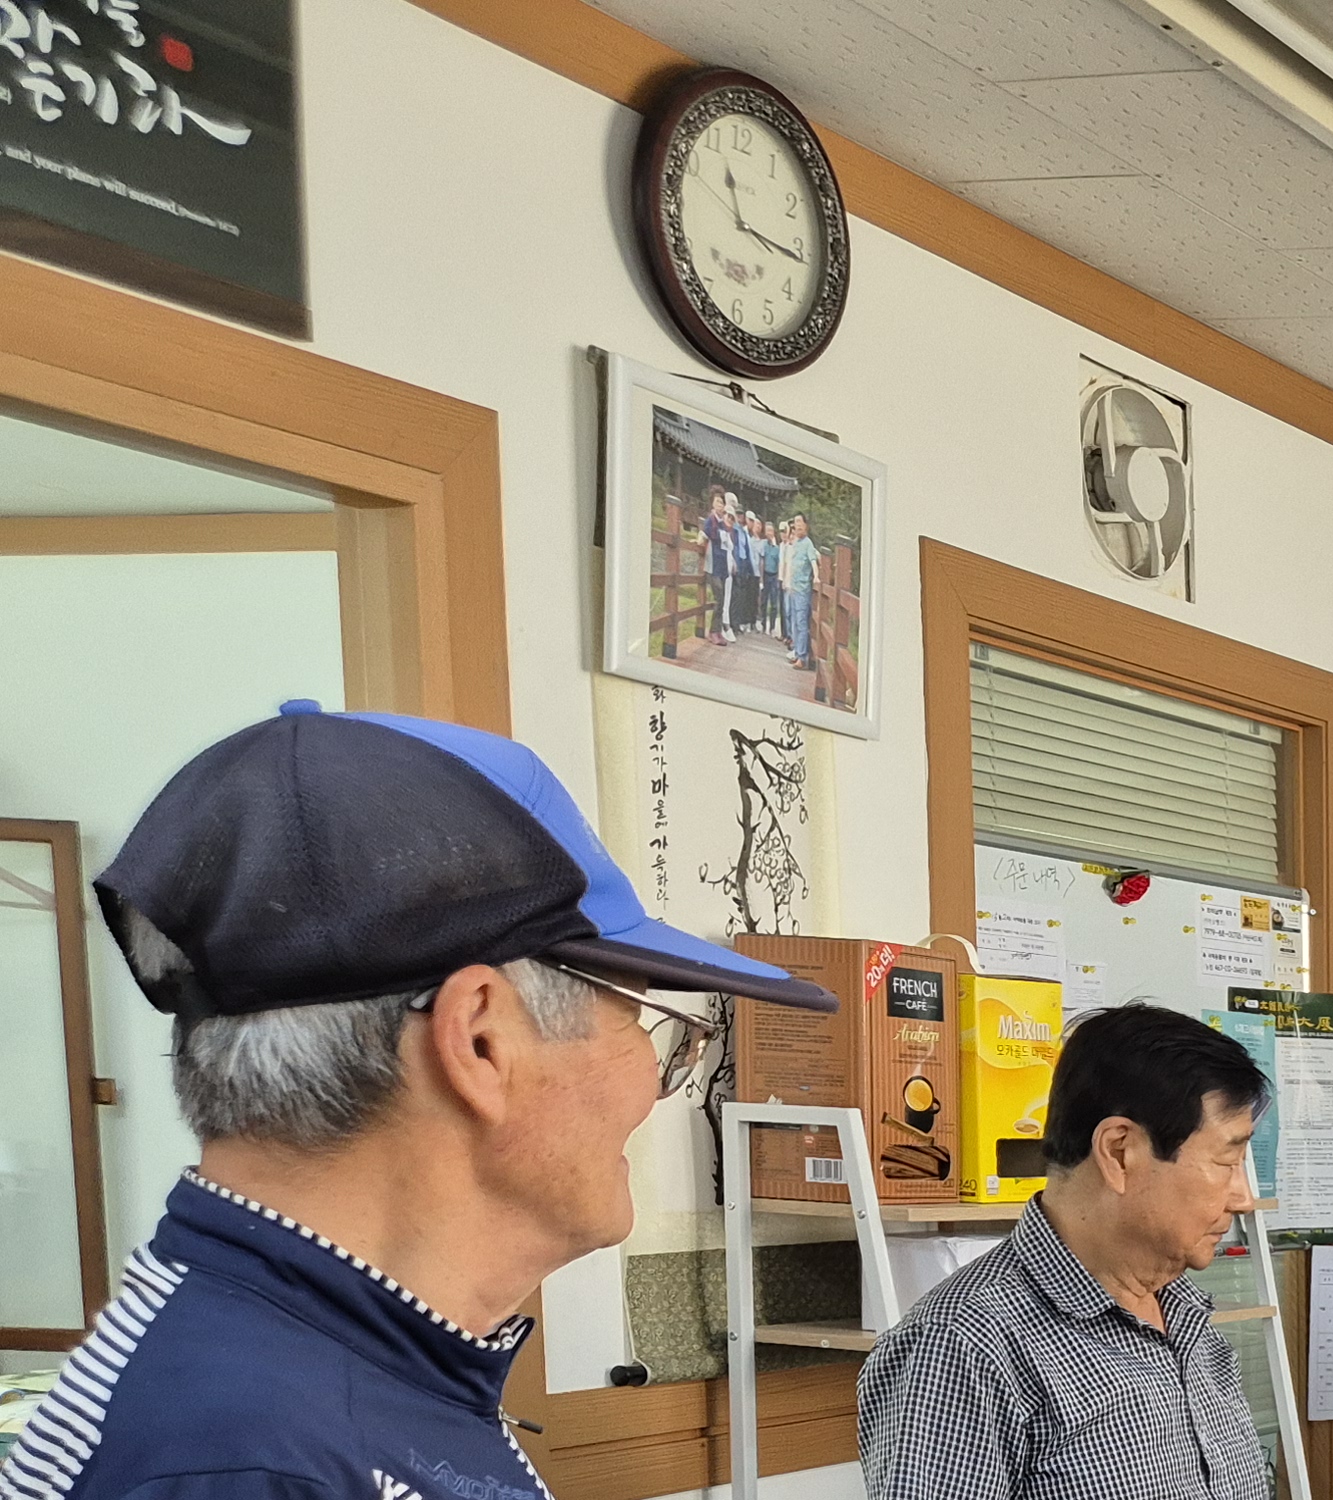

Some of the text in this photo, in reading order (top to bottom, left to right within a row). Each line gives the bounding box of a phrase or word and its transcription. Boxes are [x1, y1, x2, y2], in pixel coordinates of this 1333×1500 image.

[704, 127, 722, 154] 11
[732, 124, 753, 156] 12
[768, 153, 777, 180] 1
[786, 192, 797, 219] 2
[782, 276, 794, 302] 4
[732, 299, 743, 326] 6
[763, 299, 774, 326] 5
[892, 976, 938, 998] FRENCH
[998, 1013, 1051, 1042] Maxim
